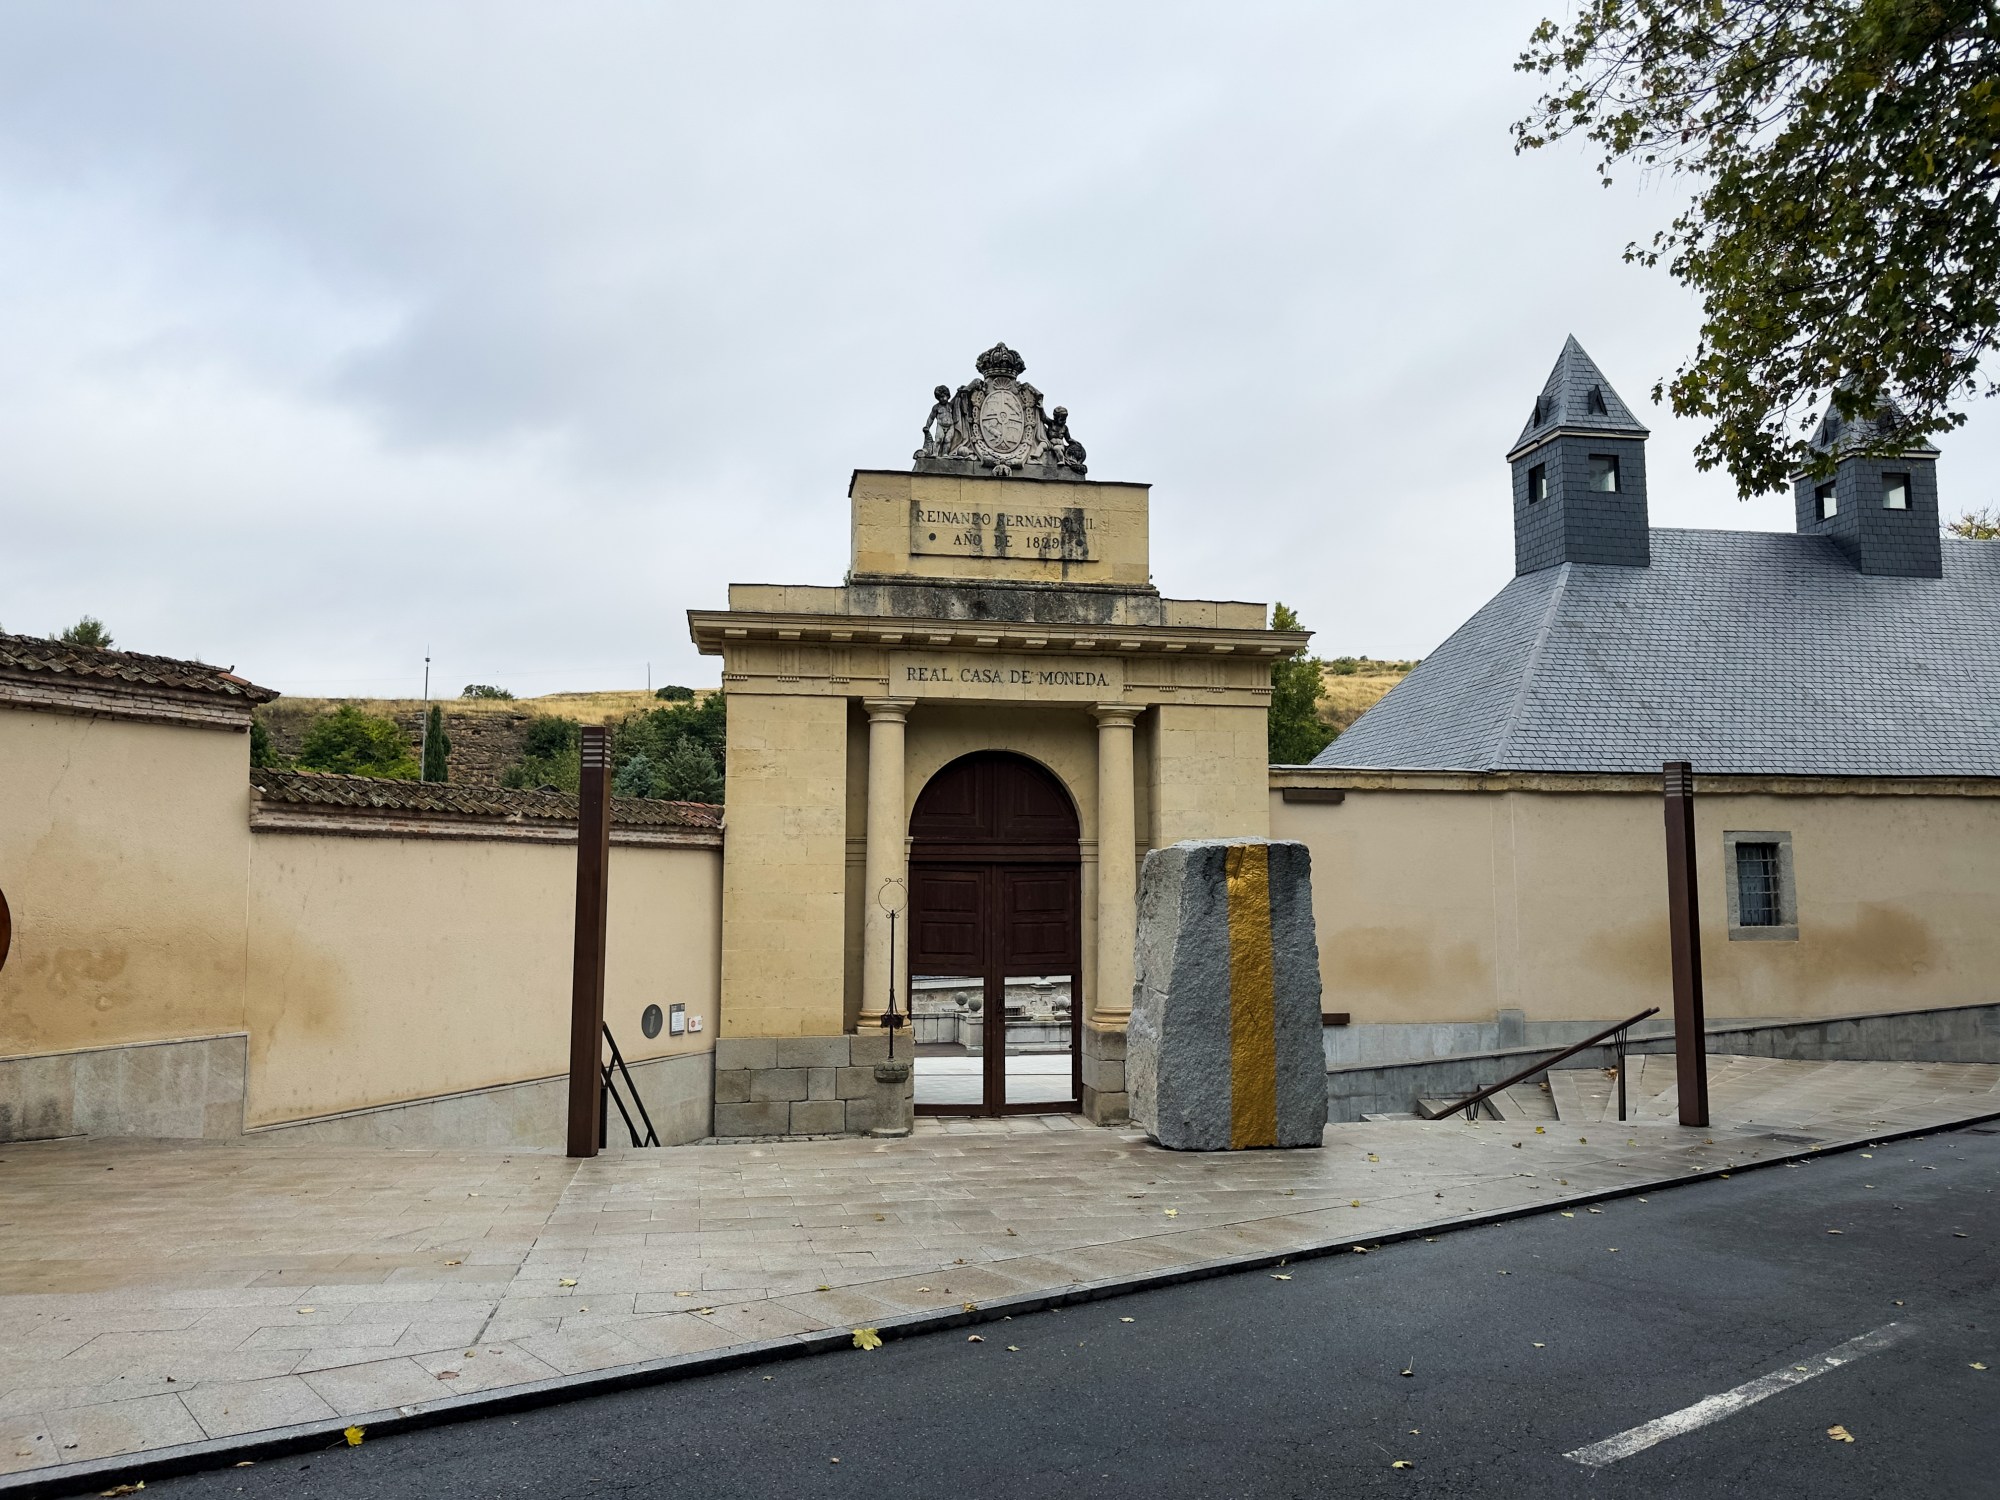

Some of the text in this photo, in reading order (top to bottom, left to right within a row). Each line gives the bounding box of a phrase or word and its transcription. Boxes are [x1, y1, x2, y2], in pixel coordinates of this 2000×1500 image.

[917, 509, 991, 526] REINANDO
[953, 528, 982, 547] AÑO
[994, 534, 1013, 548] DE
[906, 666, 1110, 687] REAL CASA DE MONEDA
